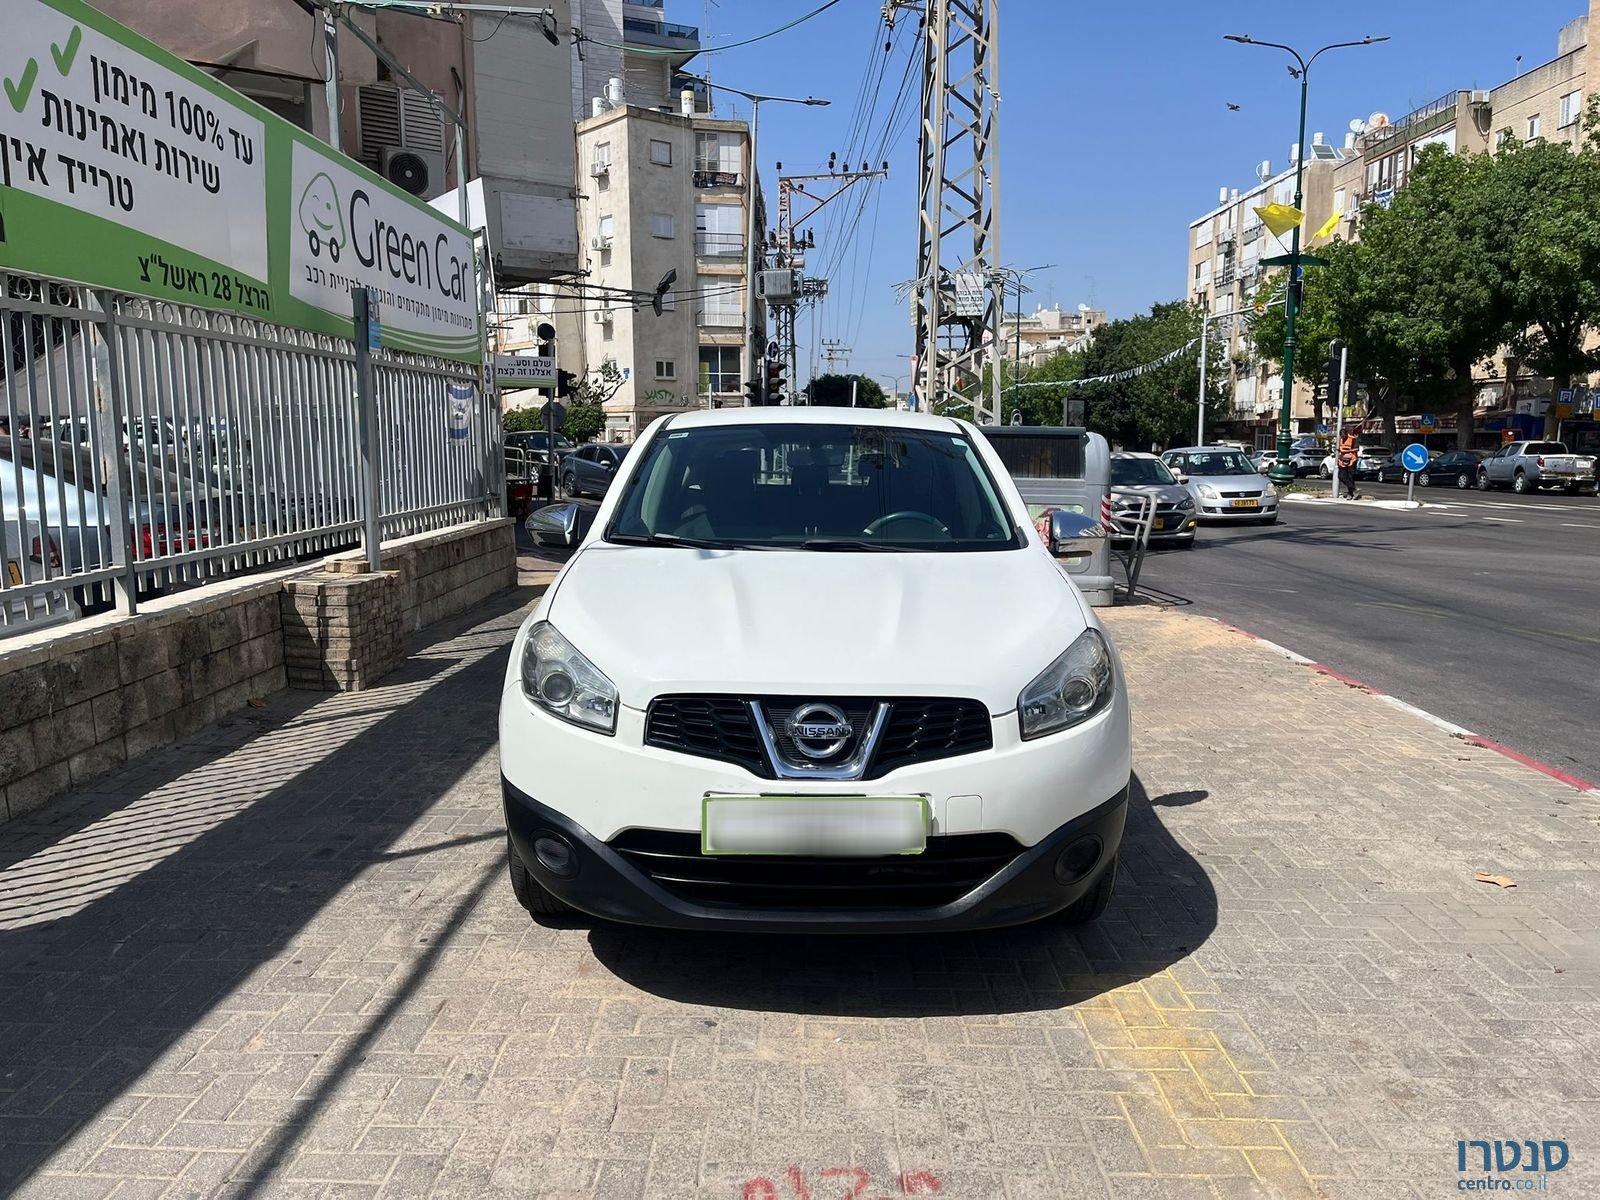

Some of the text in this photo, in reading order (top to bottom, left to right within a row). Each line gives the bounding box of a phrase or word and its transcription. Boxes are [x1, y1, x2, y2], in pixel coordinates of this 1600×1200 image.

[90, 54, 254, 165] עד 100% מימון
[41, 88, 221, 194] שירות ואמינות
[0, 133, 134, 212] טרייד אין
[349, 189, 468, 303] Green Car
[211, 271, 231, 301] 28
[305, 264, 326, 286] רכב
[234, 276, 270, 311] הרצל
[397, 295, 430, 318] מתקדמים
[431, 306, 448, 323] מימון
[450, 312, 473, 330] פתרונות
[497, 367, 515, 376] קצת
[529, 367, 552, 376] אצלנו
[533, 359, 552, 367] שלם
[794, 727, 845, 736] NISSAN
